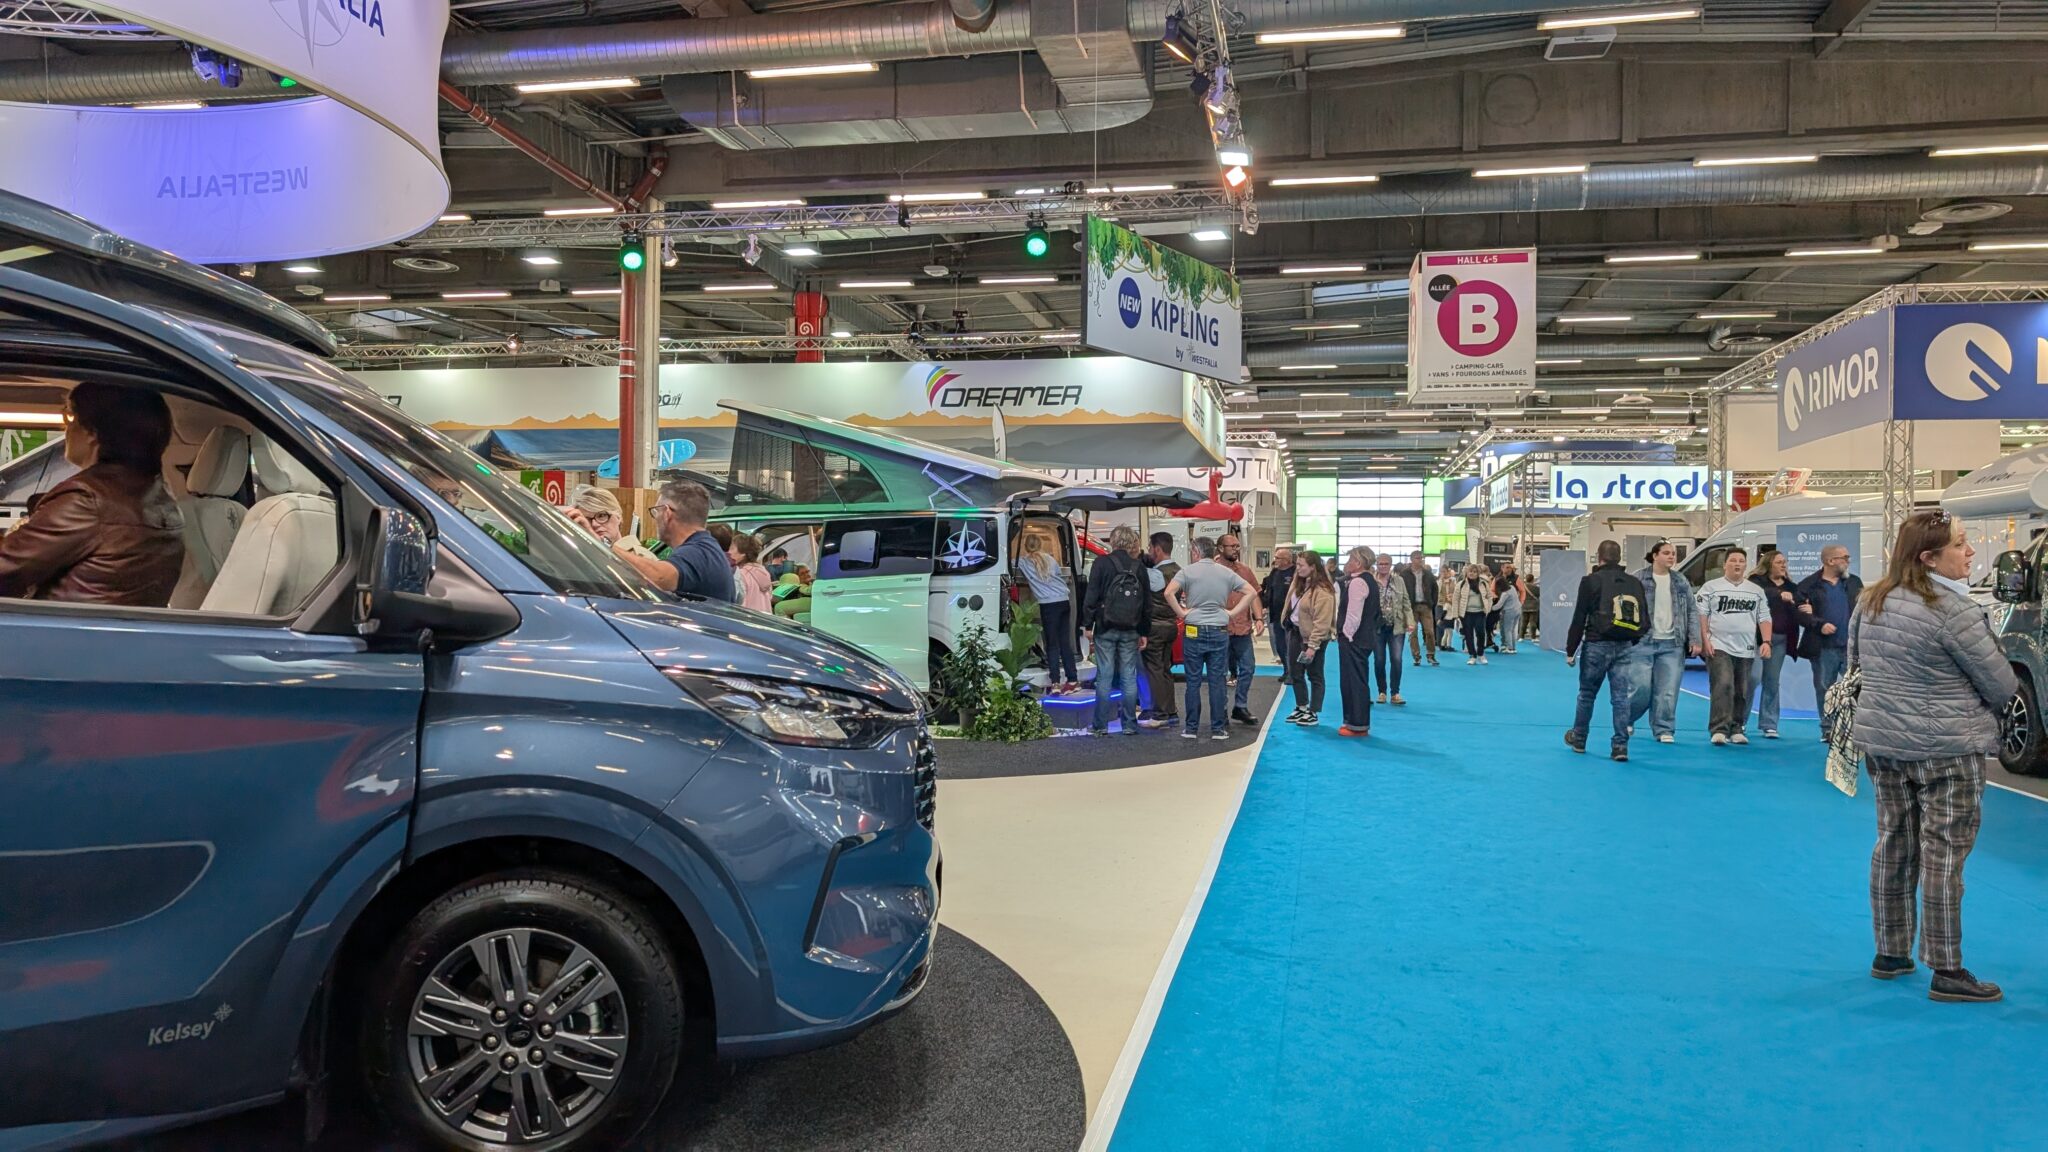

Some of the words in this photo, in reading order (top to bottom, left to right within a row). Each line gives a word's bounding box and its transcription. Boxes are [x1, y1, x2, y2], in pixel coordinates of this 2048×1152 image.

[1457, 256, 1481, 265] HALL
[1483, 255, 1498, 263] 4-5
[1430, 283, 1451, 292] ALLÉE
[1120, 293, 1140, 314] NEW
[1151, 296, 1219, 347] KIPLING
[1458, 292, 1500, 346] B
[1175, 346, 1184, 362] by
[1191, 353, 1218, 369] WESTFALIA
[1455, 362, 1504, 370] CAMPING-CARS
[1456, 370, 1490, 378] FOURGONS
[1491, 368, 1527, 377] AMÉNAGÉS
[1808, 346, 1879, 413] RIMOR
[940, 385, 1083, 408] DREAMER
[1556, 470, 1589, 500] la
[1602, 470, 1723, 500] strada
[1808, 533, 1839, 541] RIMOR
[148, 1020, 215, 1046] Kelsey
